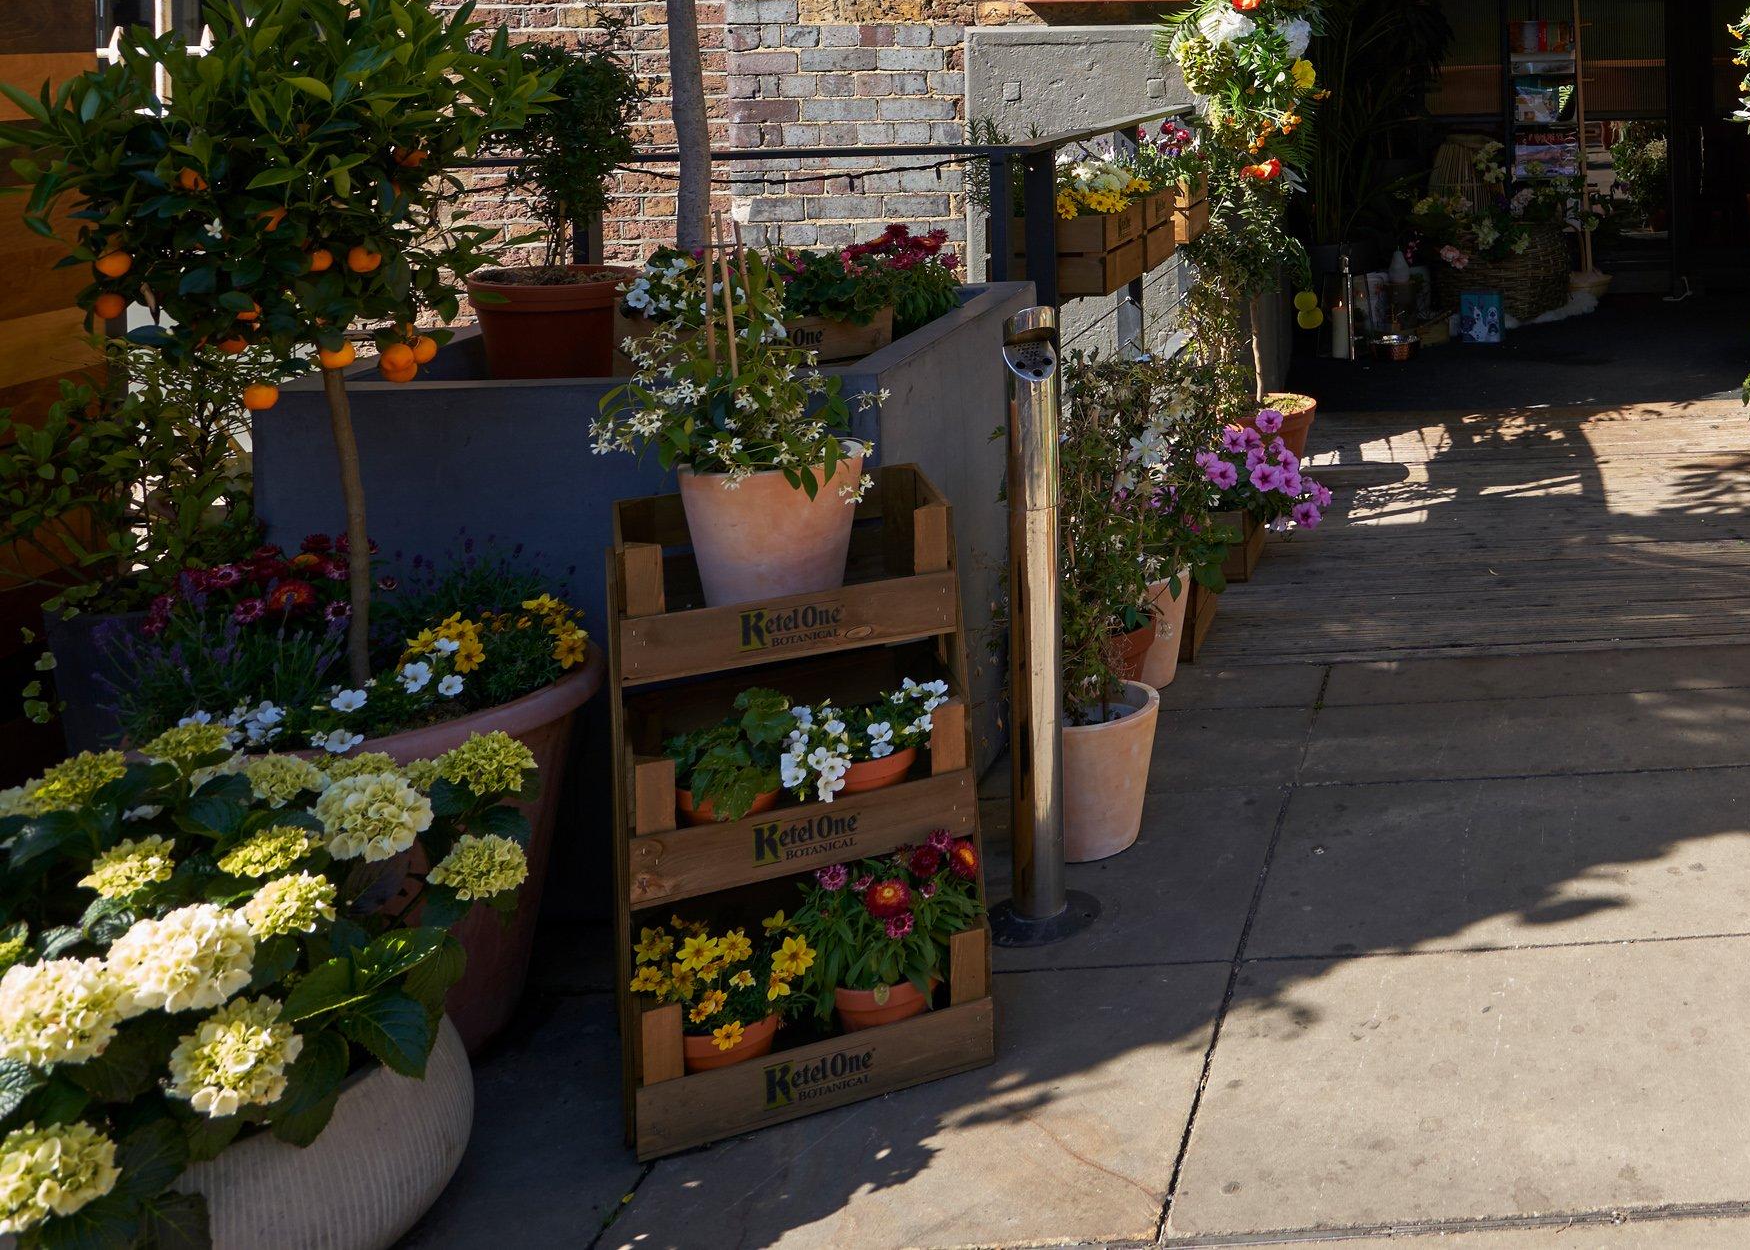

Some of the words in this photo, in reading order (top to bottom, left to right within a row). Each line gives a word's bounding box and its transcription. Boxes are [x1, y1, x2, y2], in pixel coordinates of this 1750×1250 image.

[771, 627, 840, 648] BOTANICAL
[785, 836, 857, 861] BOTANICAL
[798, 1073, 871, 1101] BOTANICAL
